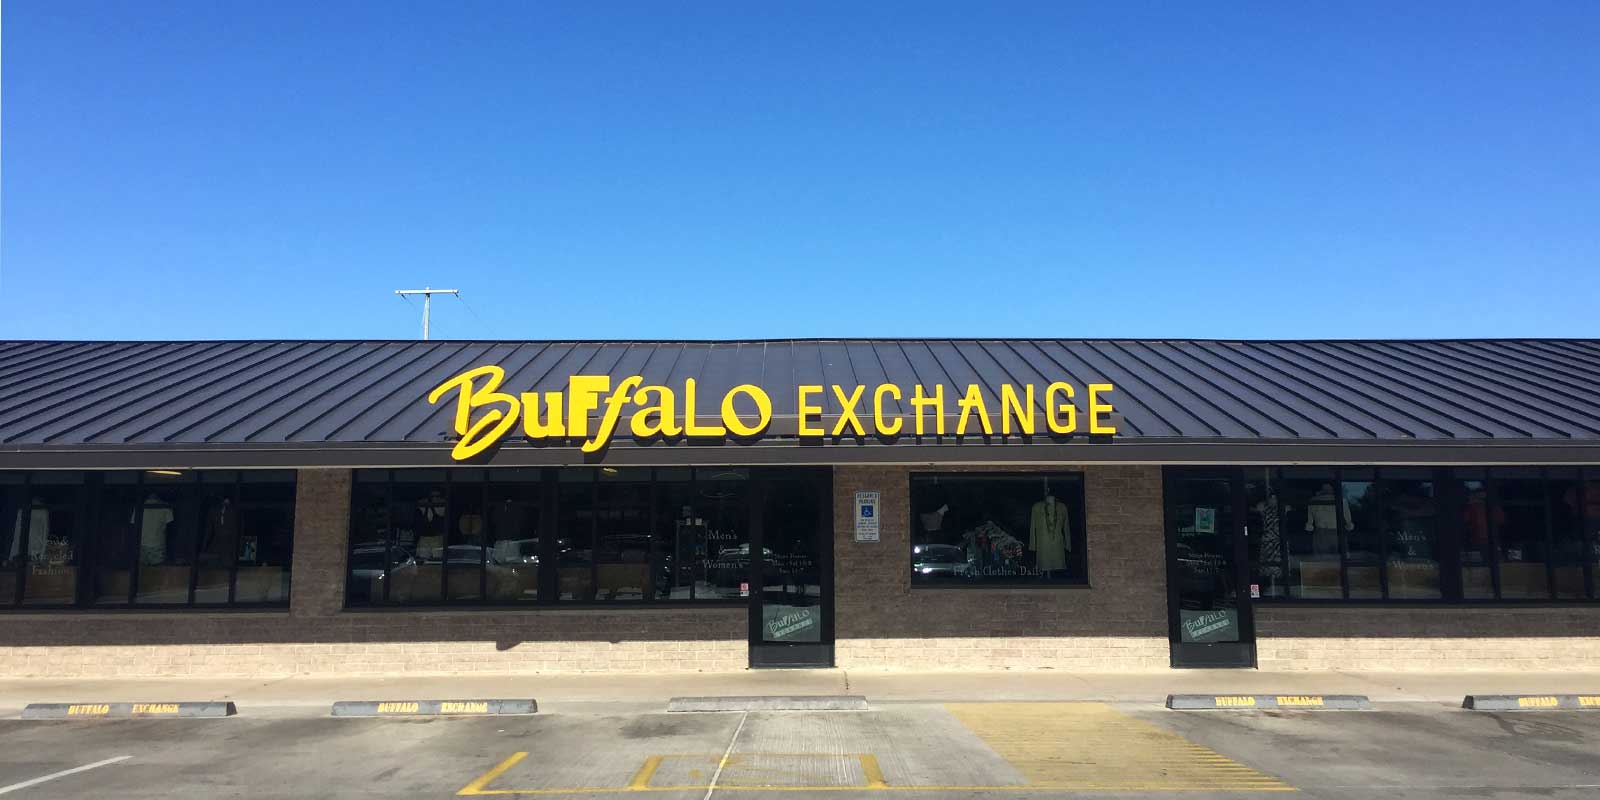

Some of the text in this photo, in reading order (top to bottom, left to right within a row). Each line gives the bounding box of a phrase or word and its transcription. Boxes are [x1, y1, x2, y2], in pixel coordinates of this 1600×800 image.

[799, 382, 1117, 436] EXCHANGE
[709, 529, 738, 540] Men's
[702, 559, 744, 570] Women's
[983, 565, 1018, 577] Clothes
[1020, 565, 1044, 578] Daily
[1215, 696, 1325, 706] BUFFALO EXCHANGE
[68, 703, 179, 715] BUFFALO EXCHANGE
[378, 702, 419, 713] BUFFALO
